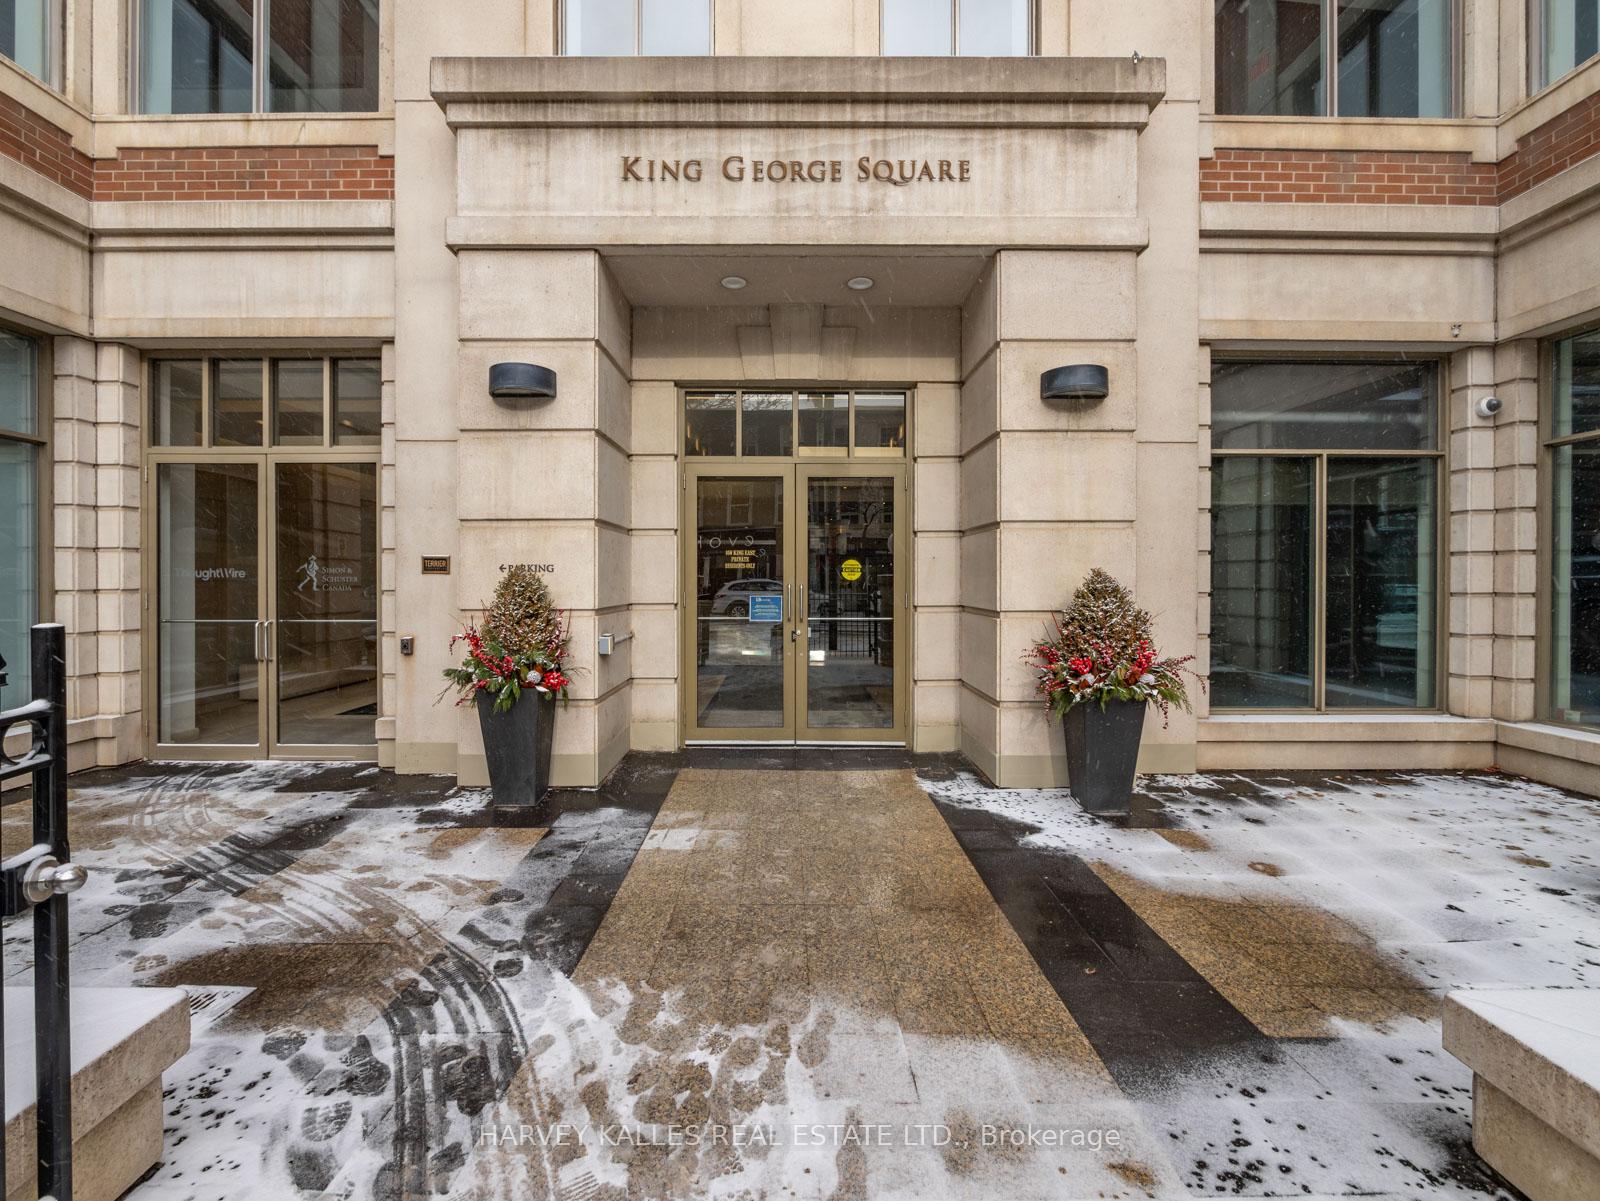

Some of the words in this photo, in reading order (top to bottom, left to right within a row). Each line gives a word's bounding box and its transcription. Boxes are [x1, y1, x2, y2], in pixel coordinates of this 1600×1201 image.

[620, 156, 702, 182] KING
[721, 156, 842, 182] GEORGE
[857, 156, 971, 186] SQUARE
